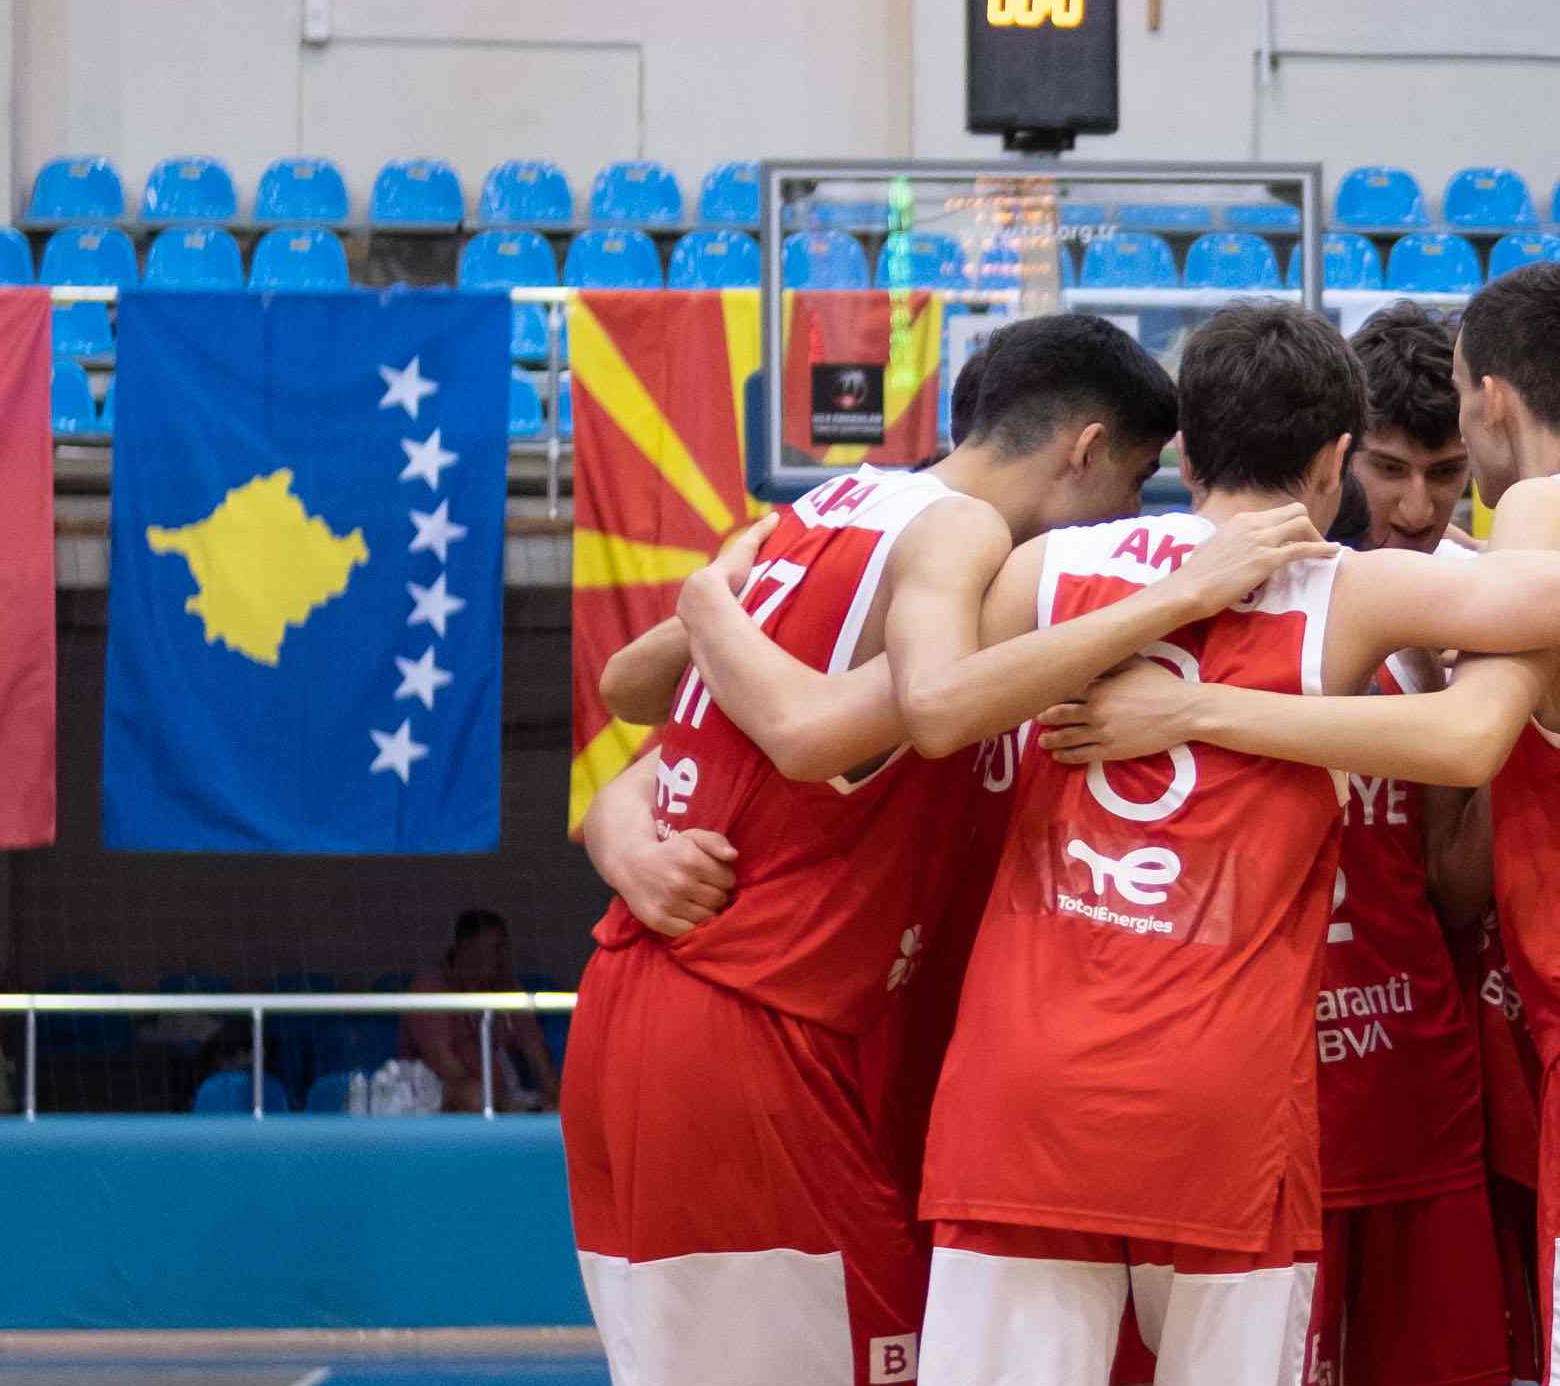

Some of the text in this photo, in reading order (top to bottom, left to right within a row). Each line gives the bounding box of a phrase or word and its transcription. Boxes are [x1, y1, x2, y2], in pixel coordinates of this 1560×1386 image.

[1057, 894, 1174, 934] TotalEnergies
[1315, 973, 1413, 1021] aranti
[1317, 1020, 1393, 1063] BVA
